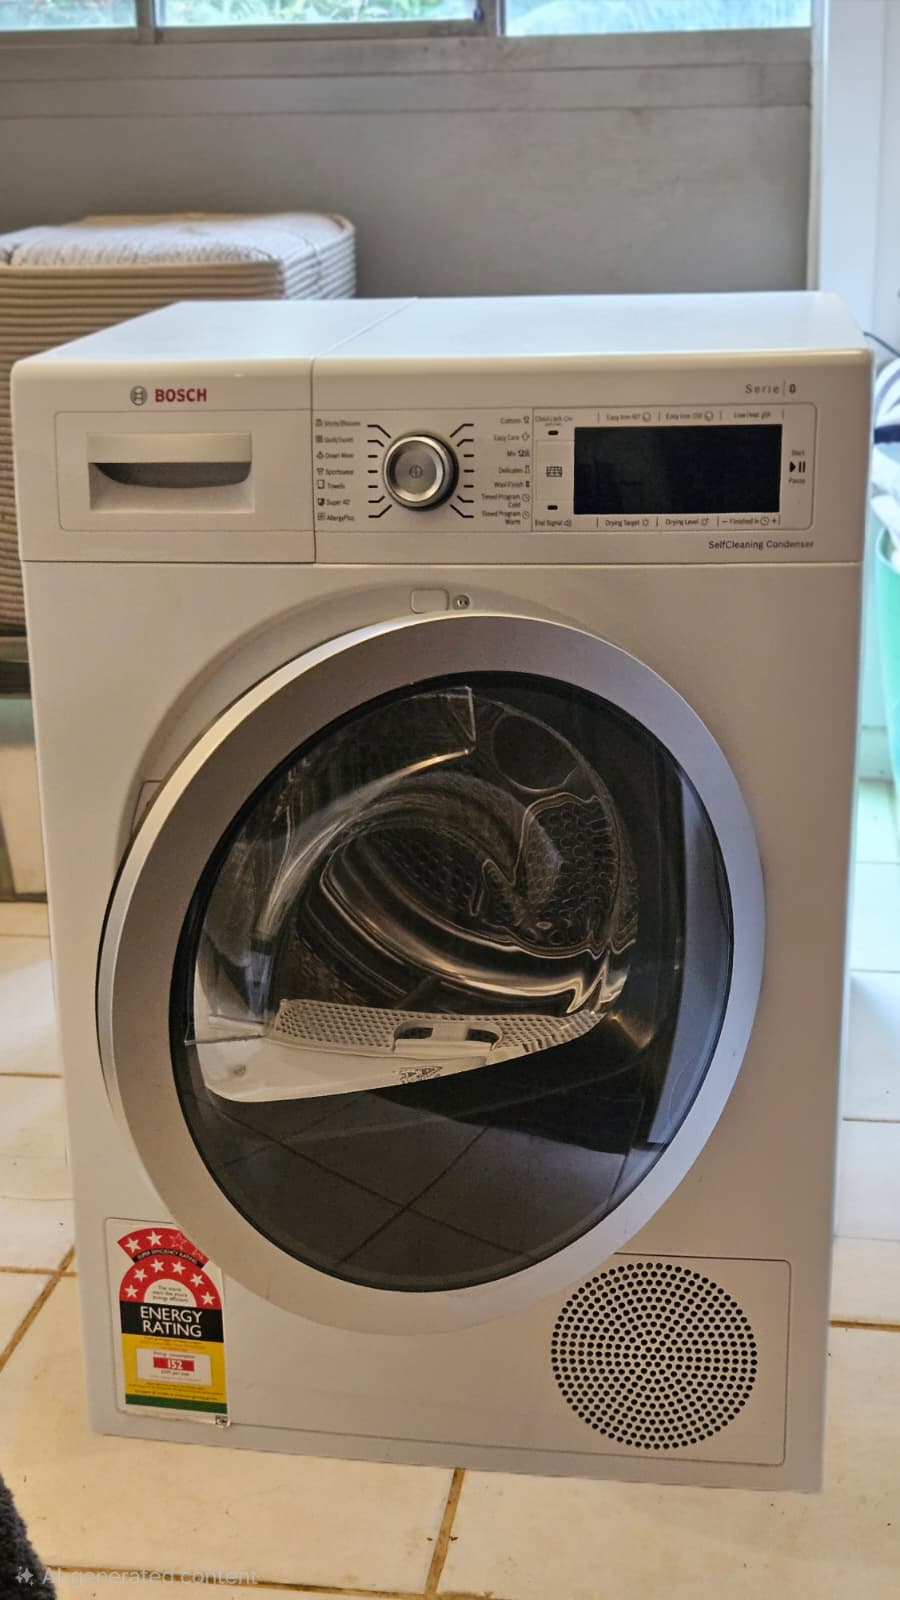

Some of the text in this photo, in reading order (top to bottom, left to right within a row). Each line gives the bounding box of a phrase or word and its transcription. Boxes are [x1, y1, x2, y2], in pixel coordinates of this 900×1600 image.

[745, 384, 780, 394] Serie
[155, 388, 207, 402] BOSCH
[605, 519, 622, 527] Drying
[665, 518, 683, 526] Drying
[708, 539, 814, 551] SelfCleaning Condenser
[140, 1306, 203, 1324] ENERGY
[142, 1322, 203, 1338] RATING
[167, 1359, 183, 1370] 152
